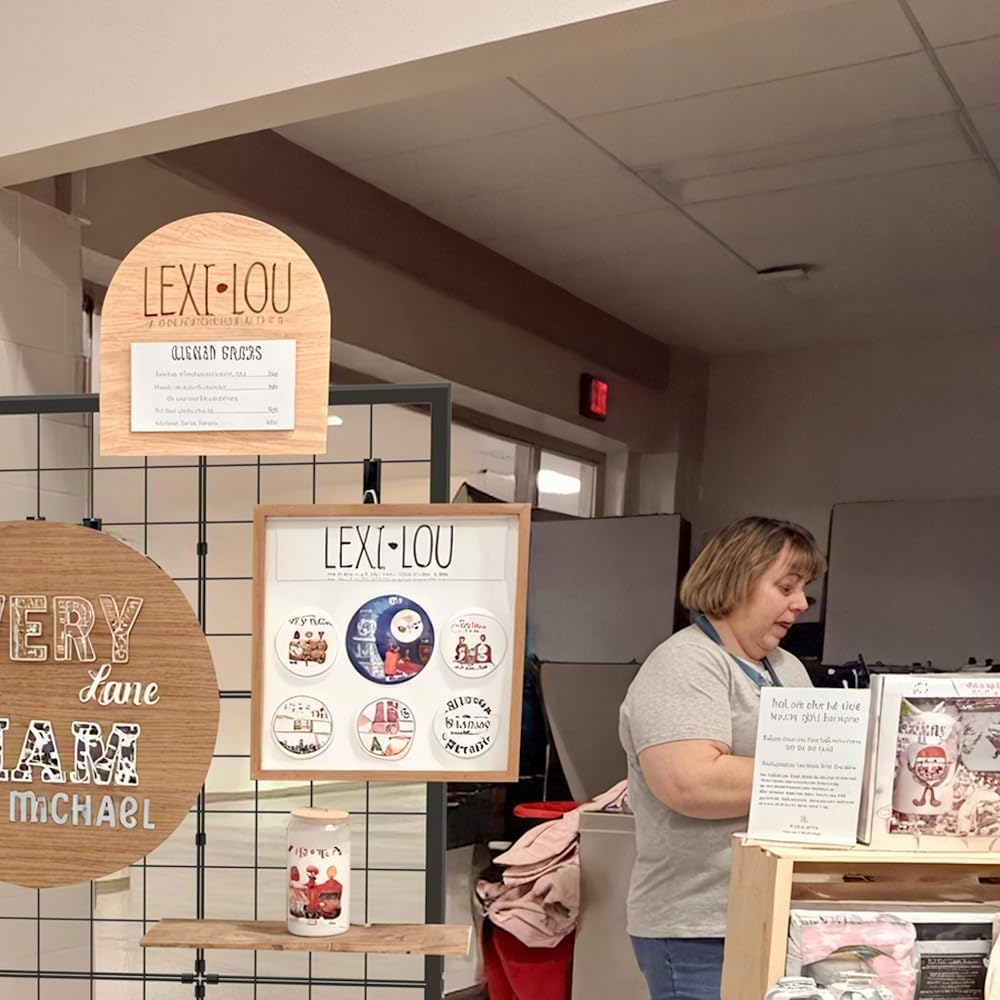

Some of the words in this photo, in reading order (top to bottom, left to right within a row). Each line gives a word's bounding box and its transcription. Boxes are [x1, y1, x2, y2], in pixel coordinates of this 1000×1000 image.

[143, 263, 216, 317] LEXI
[232, 261, 292, 315] LOU
[324, 525, 386, 569] LEXI
[401, 524, 454, 569] LOU
